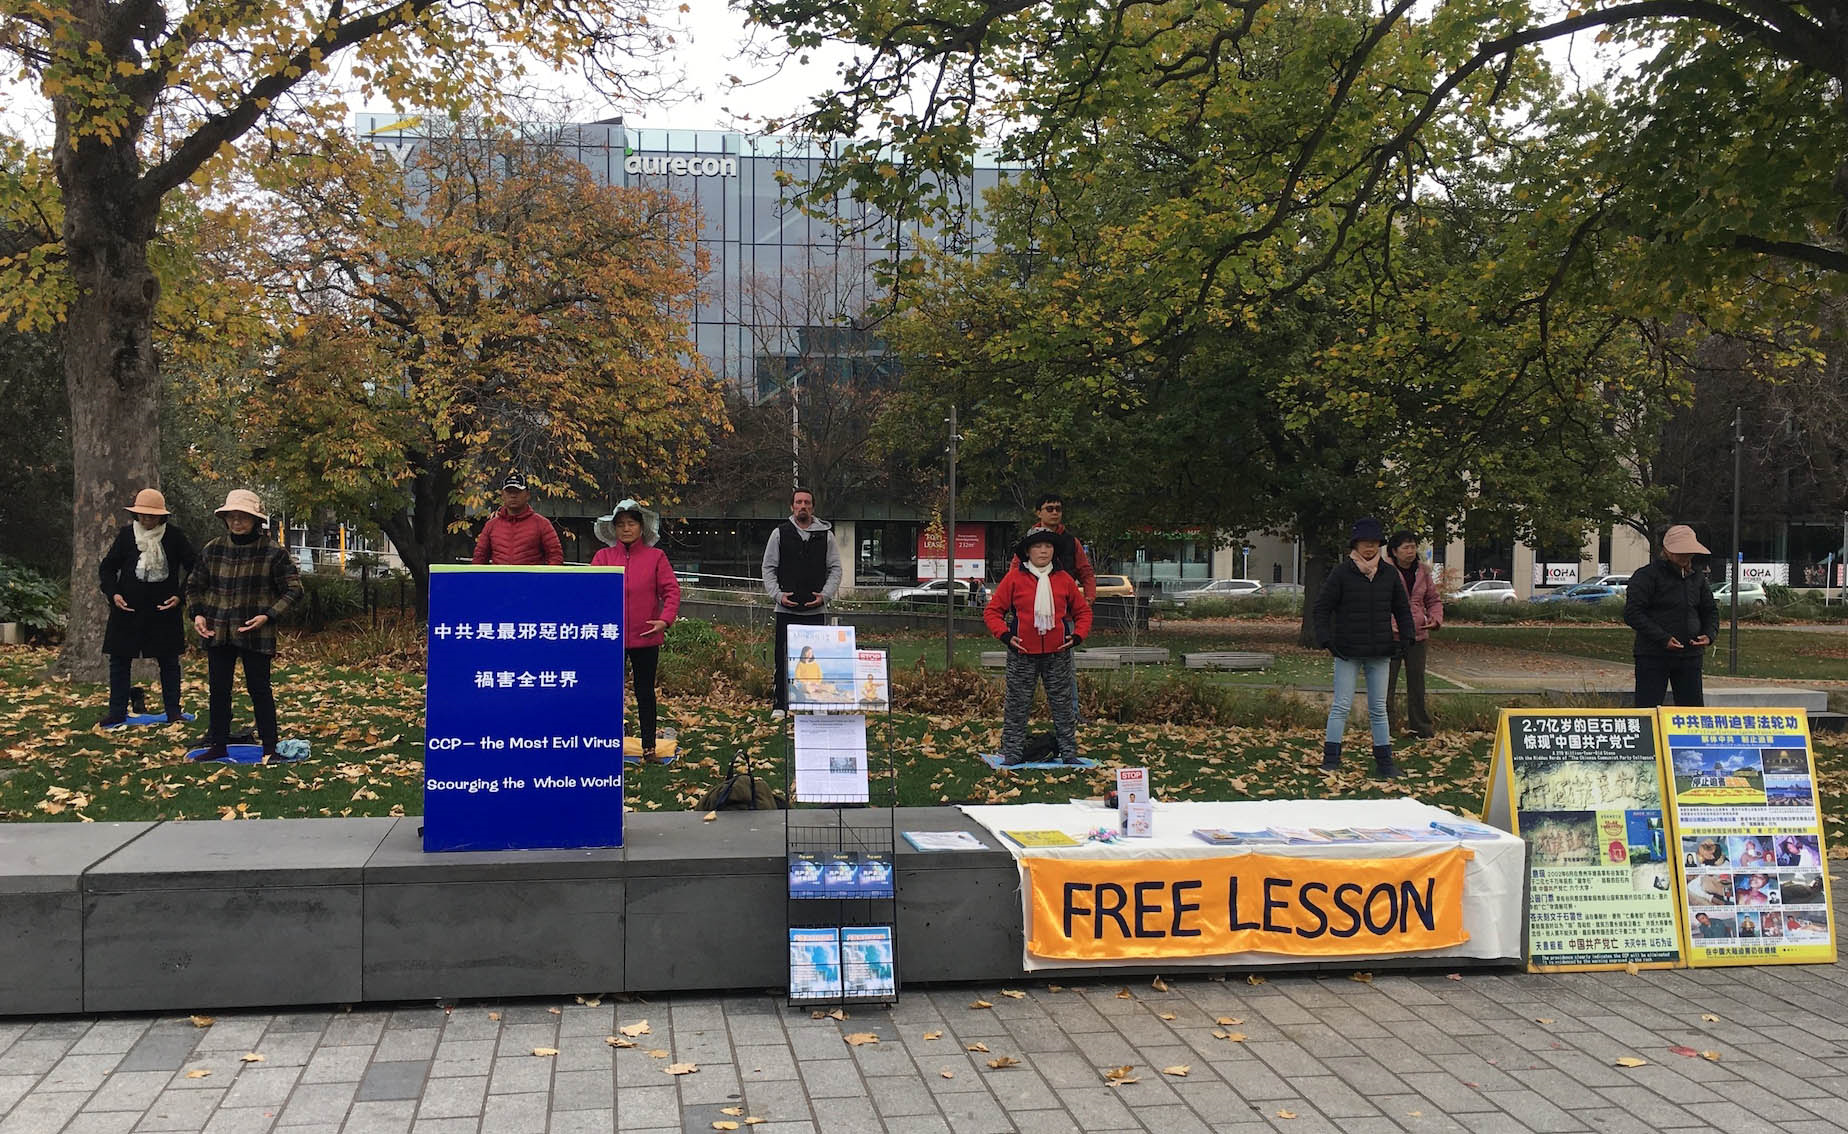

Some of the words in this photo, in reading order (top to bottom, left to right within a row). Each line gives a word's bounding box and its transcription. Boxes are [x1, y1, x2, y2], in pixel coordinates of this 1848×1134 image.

[624, 156, 737, 177] aurecon
[1546, 568, 1576, 577] KOHA
[1743, 568, 1771, 577] KOHA
[434, 623, 620, 640] 中共是最邪惡的病毒
[474, 670, 579, 688] 禍害全世界
[1522, 718, 1640, 733] 2.7亿岁的巨石崩裂
[1672, 715, 1798, 730] 中共酷刑迫害法轮功
[480, 736, 504, 750] the
[509, 736, 548, 749] Most
[552, 736, 578, 748] Evil
[582, 736, 620, 748] Virus
[426, 778, 500, 793] Scourging
[502, 776, 525, 788] the
[534, 776, 576, 788] Whole
[580, 774, 622, 788] World
[1064, 881, 1202, 939] FREE
[1229, 876, 1435, 938] LESSON
[1569, 938, 1618, 950] 中国共产党亡
